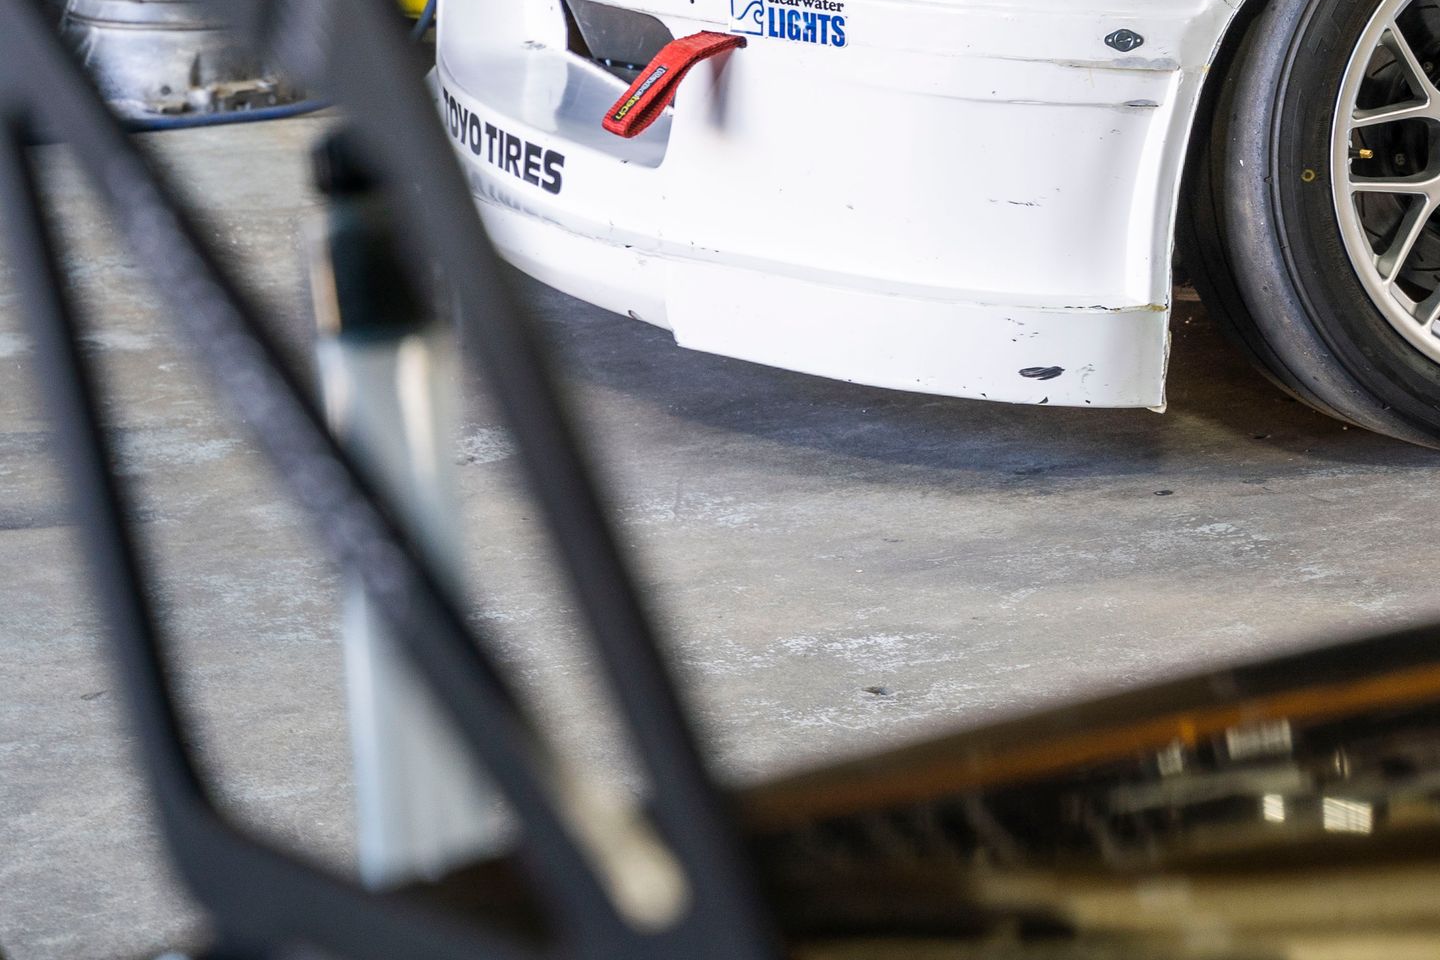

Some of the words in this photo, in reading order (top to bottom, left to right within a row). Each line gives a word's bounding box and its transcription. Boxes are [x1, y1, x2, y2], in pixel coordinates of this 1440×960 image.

[768, 6, 846, 48] LIGHTS
[442, 86, 482, 156] TOYO
[485, 122, 566, 195] TIRES
